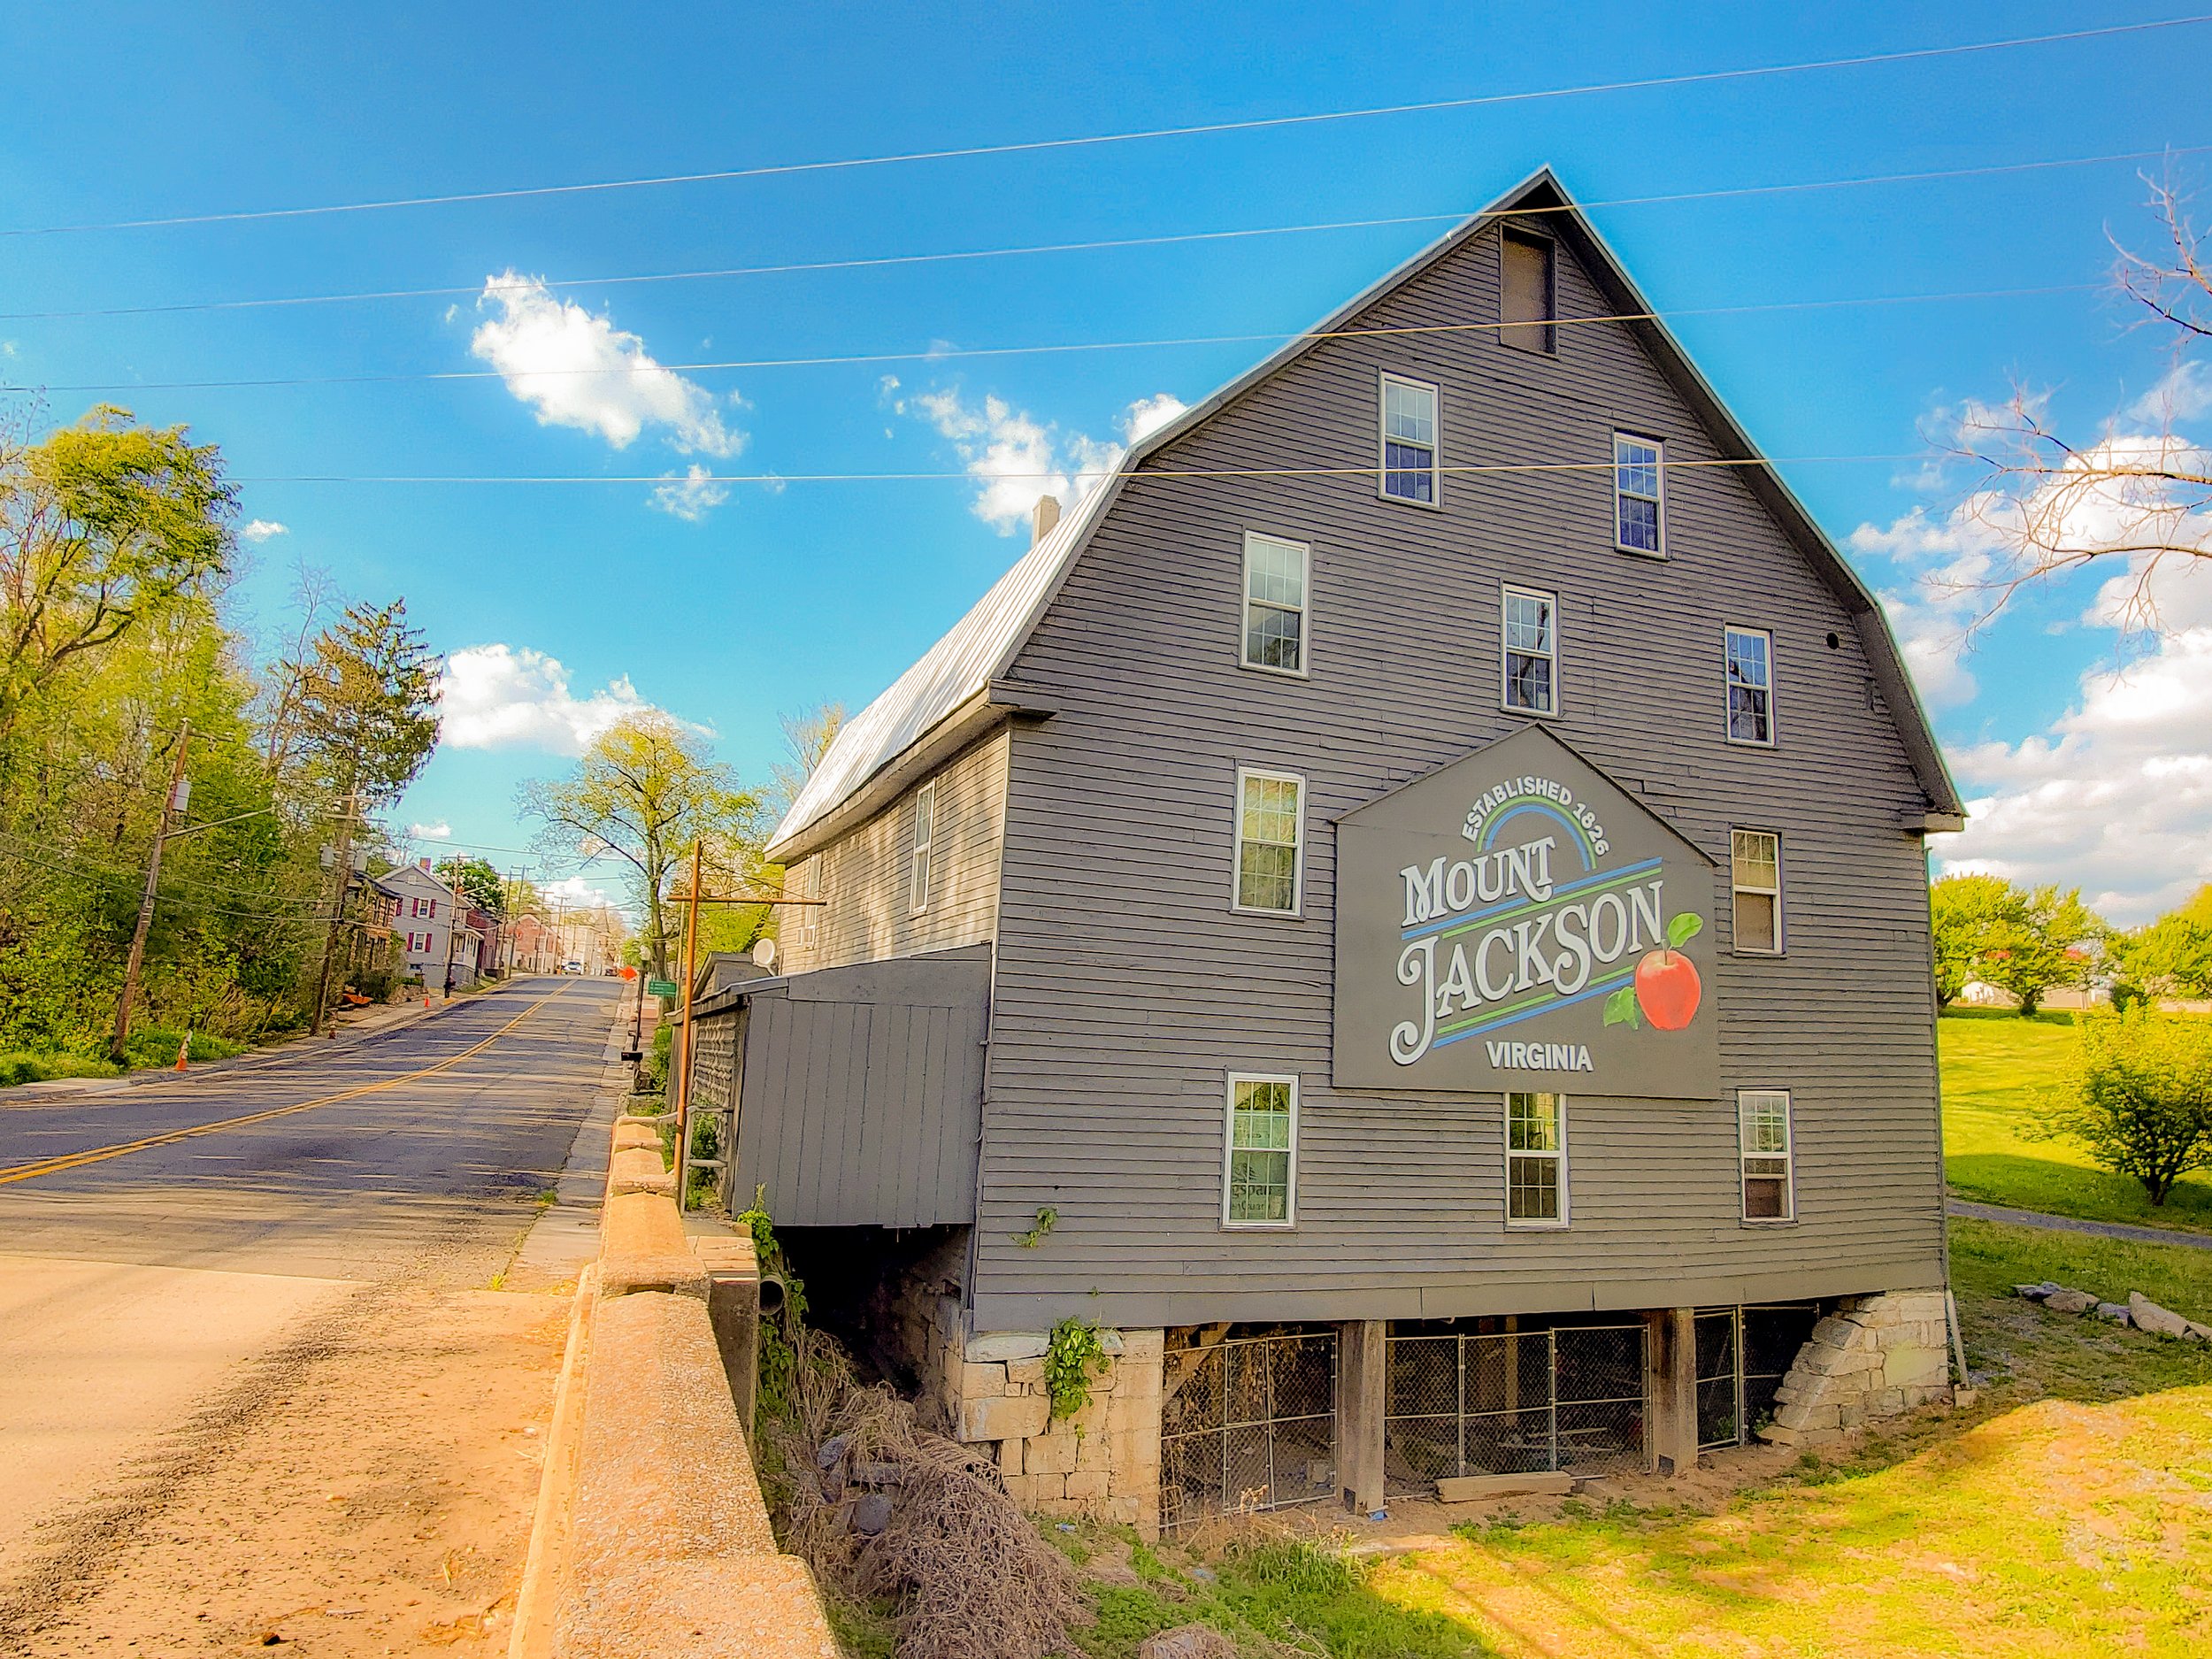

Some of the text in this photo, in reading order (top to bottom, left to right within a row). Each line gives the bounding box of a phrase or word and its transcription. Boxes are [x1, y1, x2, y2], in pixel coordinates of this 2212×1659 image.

[1462, 775, 1609, 856] ESTABLISHED 1826
[1400, 836, 1555, 927] MOUNT
[1389, 880, 1663, 1065] JACKSON
[1486, 1041, 1594, 1071] VIRGINIA
